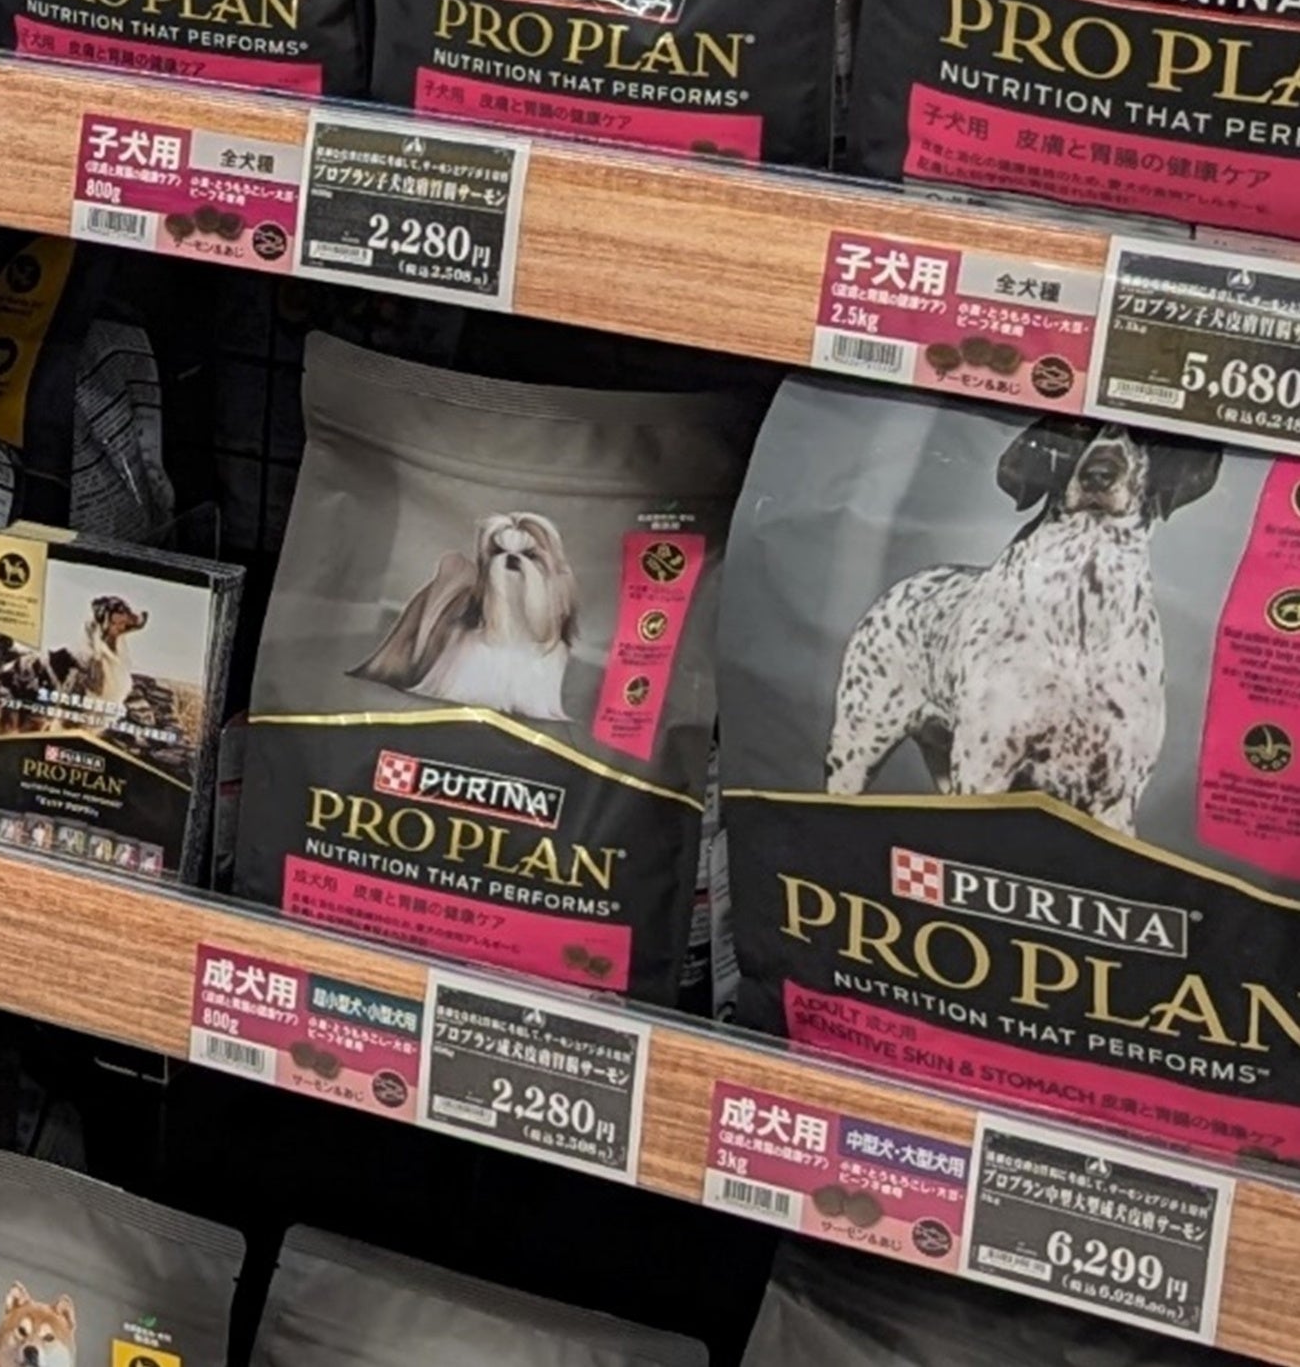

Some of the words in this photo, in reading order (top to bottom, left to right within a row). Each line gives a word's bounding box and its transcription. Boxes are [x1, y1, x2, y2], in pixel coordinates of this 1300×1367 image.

[131, 17, 183, 40] THAT
[188, 26, 301, 55] PERFORMS
[562, 17, 746, 78] PLAN
[433, 48, 541, 84] NUTRITION
[548, 71, 606, 94] THAT
[613, 81, 739, 107] PERFORMS
[940, 60, 1113, 118] NUTRITION
[1125, 101, 1213, 134] THAT
[87, 124, 182, 170] 子犬用
[923, 102, 990, 141] 子犬用
[220, 148, 275, 174] 全犬種
[84, 178, 122, 204] 800g
[368, 214, 492, 269] 2,280円
[834, 242, 949, 296] 子犬用
[994, 272, 1062, 303] 全犬種
[830, 301, 880, 333] 2.5kg
[21, 756, 68, 781] PRO
[69, 768, 122, 796] PLAN
[420, 765, 550, 824] PURINA
[305, 787, 436, 853] PRO
[443, 817, 614, 890] PLAN
[305, 839, 420, 881] NUTRITION
[426, 866, 482, 893] THAT
[489, 879, 612, 917] PERFORMS
[950, 870, 1176, 951] PURINA
[202, 956, 298, 1012] 成犬用
[778, 873, 992, 993] PRO
[1011, 937, 1300, 1055] PLAN
[202, 1006, 240, 1037] 800g
[313, 983, 418, 1035] 超小型犬・小型犬用
[834, 968, 988, 1029] NUTRITION
[997, 1008, 1075, 1048] THAT
[1087, 1031, 1258, 1086] PERFORMS
[903, 1041, 954, 1076] SKIN
[958, 1056, 974, 1080] &
[979, 1062, 1098, 1106] STOMACH
[491, 1076, 615, 1145] 2,280円
[719, 1096, 829, 1154] 成犬用
[716, 1148, 749, 1176] 3kg
[845, 1125, 966, 1179] 中型犬・大型犬用
[1046, 1228, 1189, 1304] 6,299円
